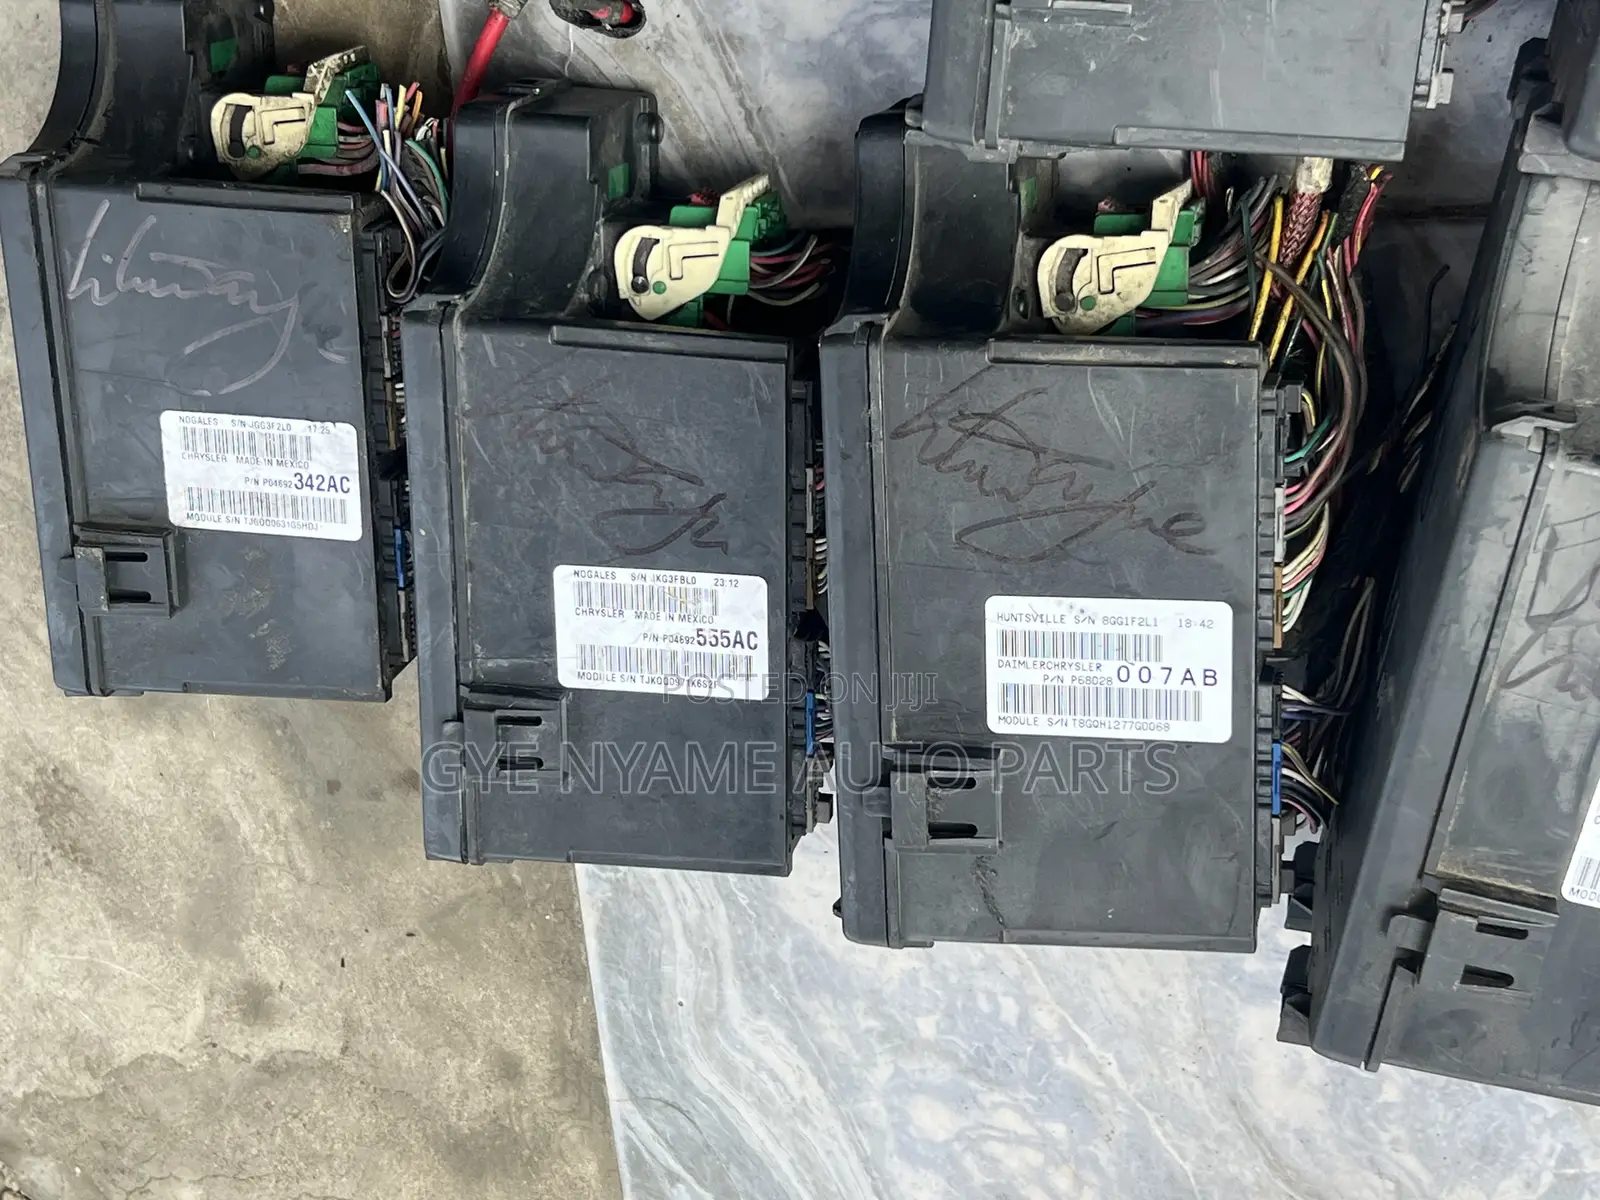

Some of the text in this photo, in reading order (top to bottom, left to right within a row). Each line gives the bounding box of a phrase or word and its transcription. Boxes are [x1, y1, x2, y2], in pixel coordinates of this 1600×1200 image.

[178, 415, 219, 426] NOGALES
[231, 418, 247, 428] S/N
[181, 451, 310, 470] CHRYSLER MADE IN MEXICO
[244, 476, 260, 486] P/N
[186, 512, 222, 524] MODULE
[225, 515, 240, 525] S/N
[573, 570, 617, 580] NOGALES
[630, 572, 648, 583] S/N
[713, 578, 740, 588] 23:12
[574, 608, 714, 624] CHRYSLER MADE IN MEXICO
[996, 612, 1066, 624] HUNTSVILLE
[1074, 615, 1096, 626] S/N
[1177, 618, 1214, 629] 18:42
[642, 632, 659, 642] P/N
[997, 660, 1102, 672] DAIMLERCHRYSLER
[578, 671, 616, 682] MODULE
[620, 675, 637, 684] S/N
[1042, 674, 1065, 684] P/N
[1070, 675, 1113, 686] P68028
[998, 715, 1040, 726] MODULE
[1047, 717, 1068, 728] S/N
